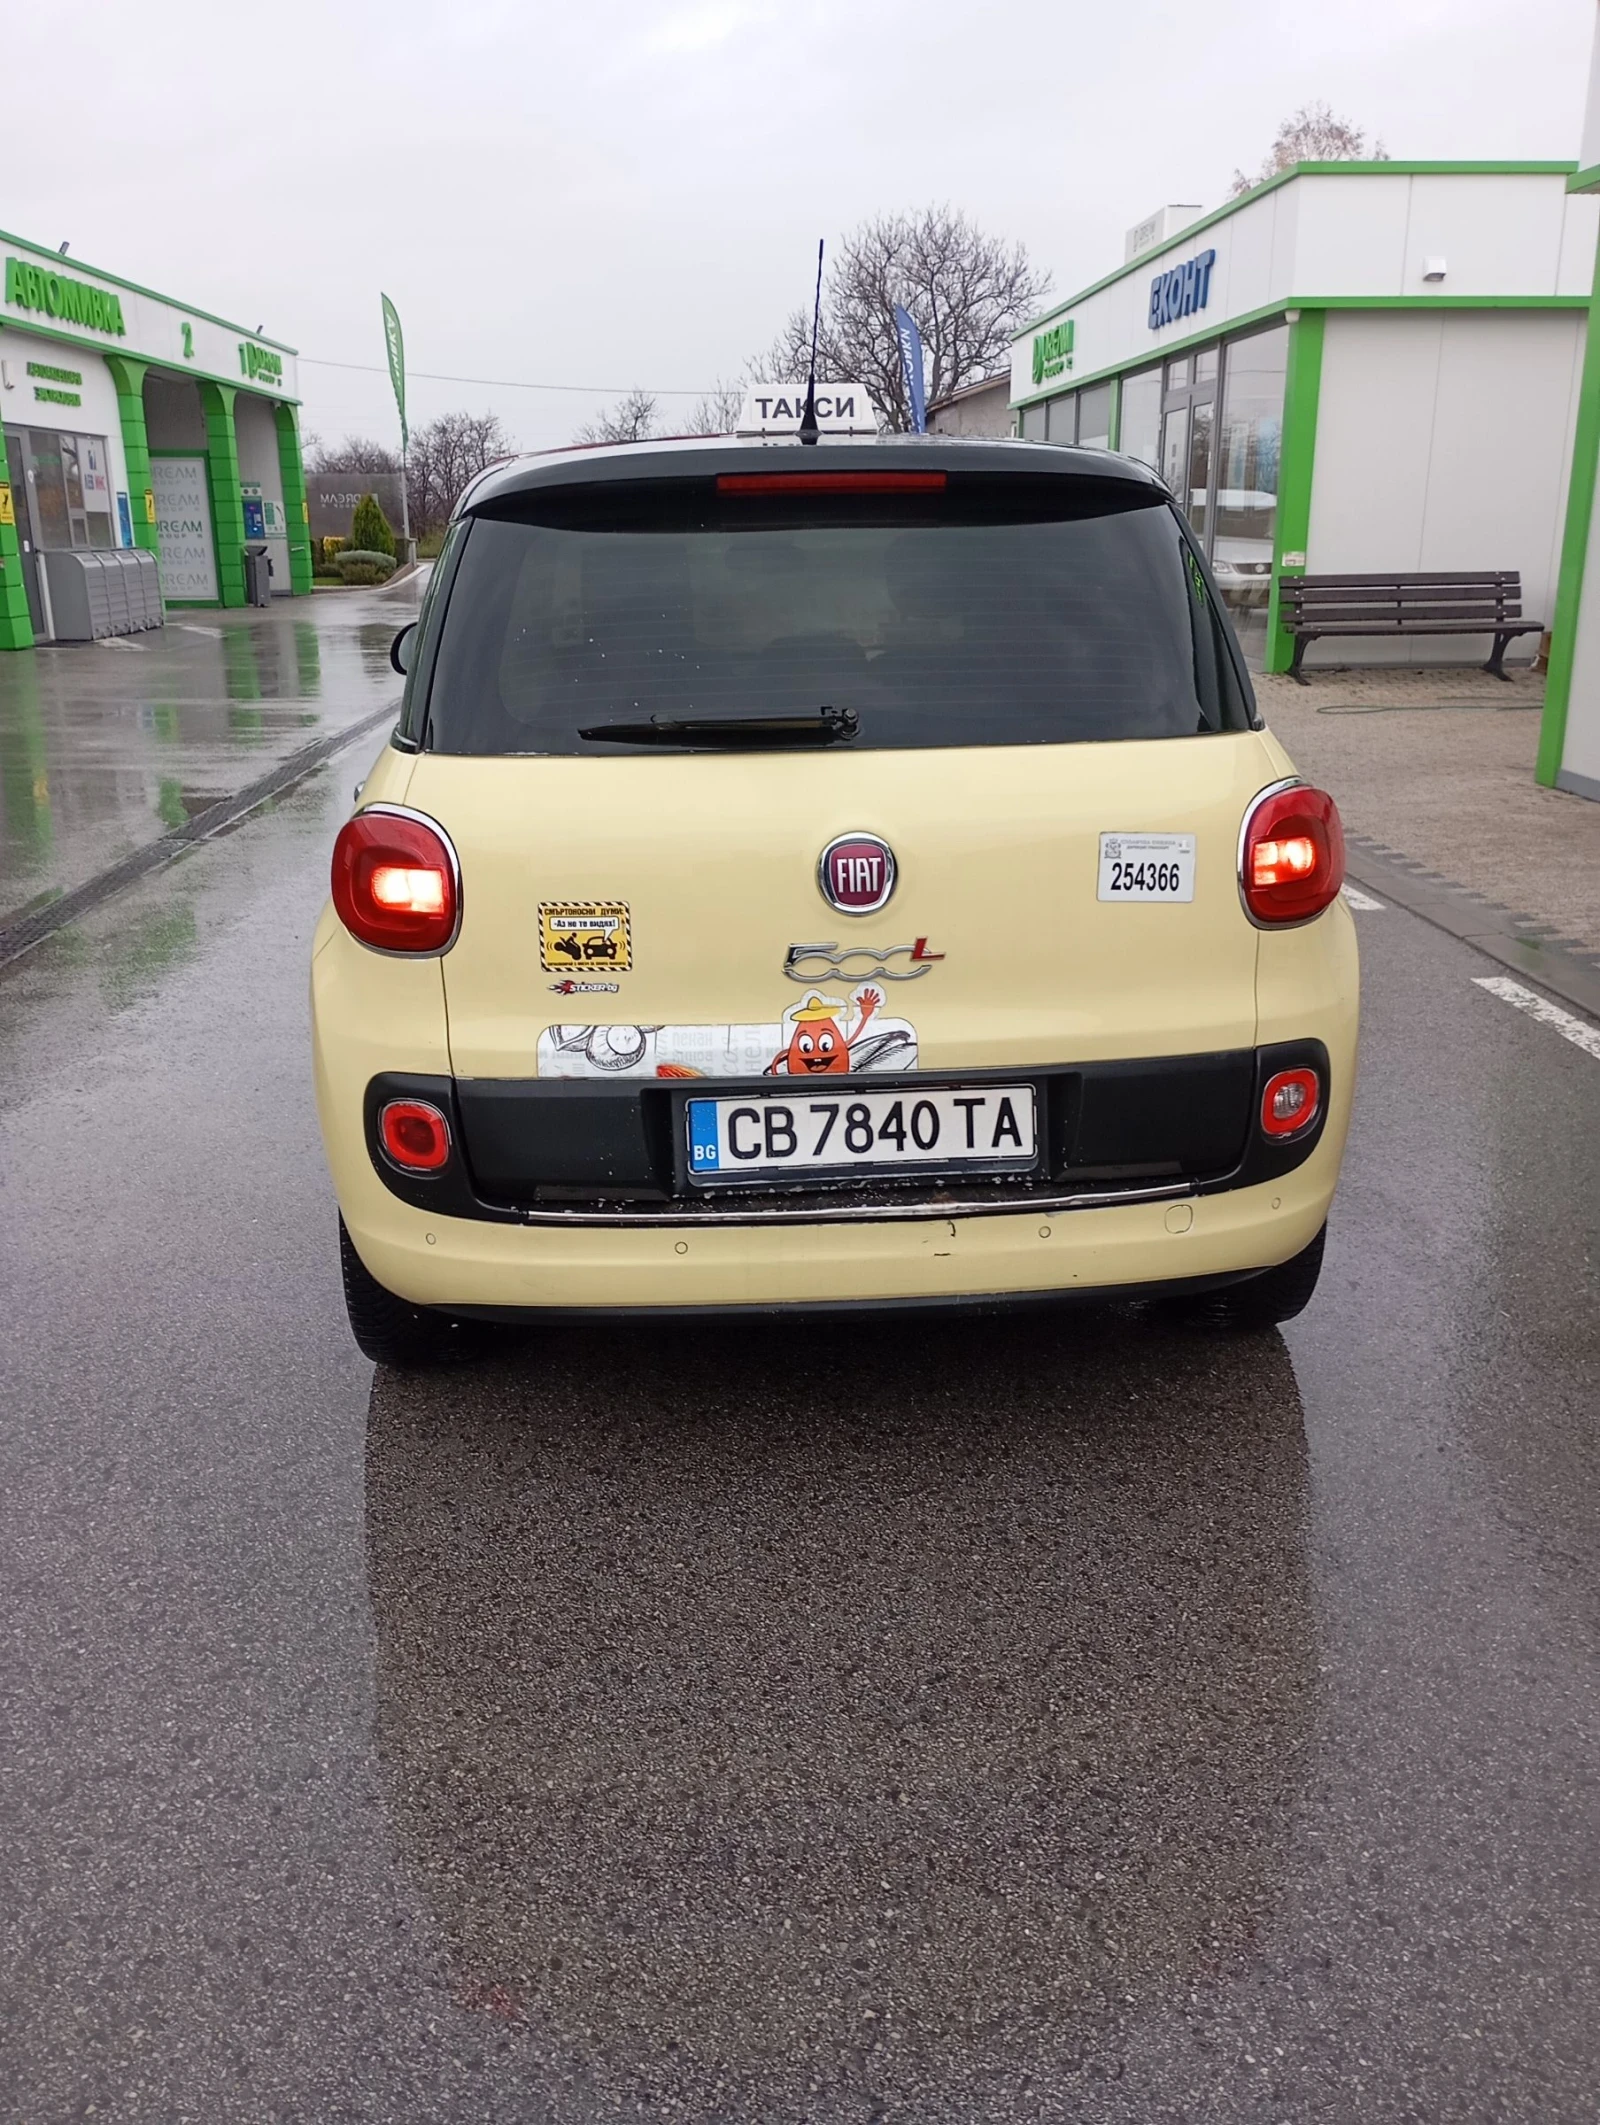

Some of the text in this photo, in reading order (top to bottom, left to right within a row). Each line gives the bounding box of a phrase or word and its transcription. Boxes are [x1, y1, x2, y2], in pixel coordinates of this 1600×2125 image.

[5, 257, 195, 359] АВТОМИВКА 2
[755, 397, 855, 419] ТАКСИ
[836, 857, 882, 893] FIAT
[1110, 862, 1180, 892] 254366
[693, 1096, 1024, 1161] BG CB 7840 TA
